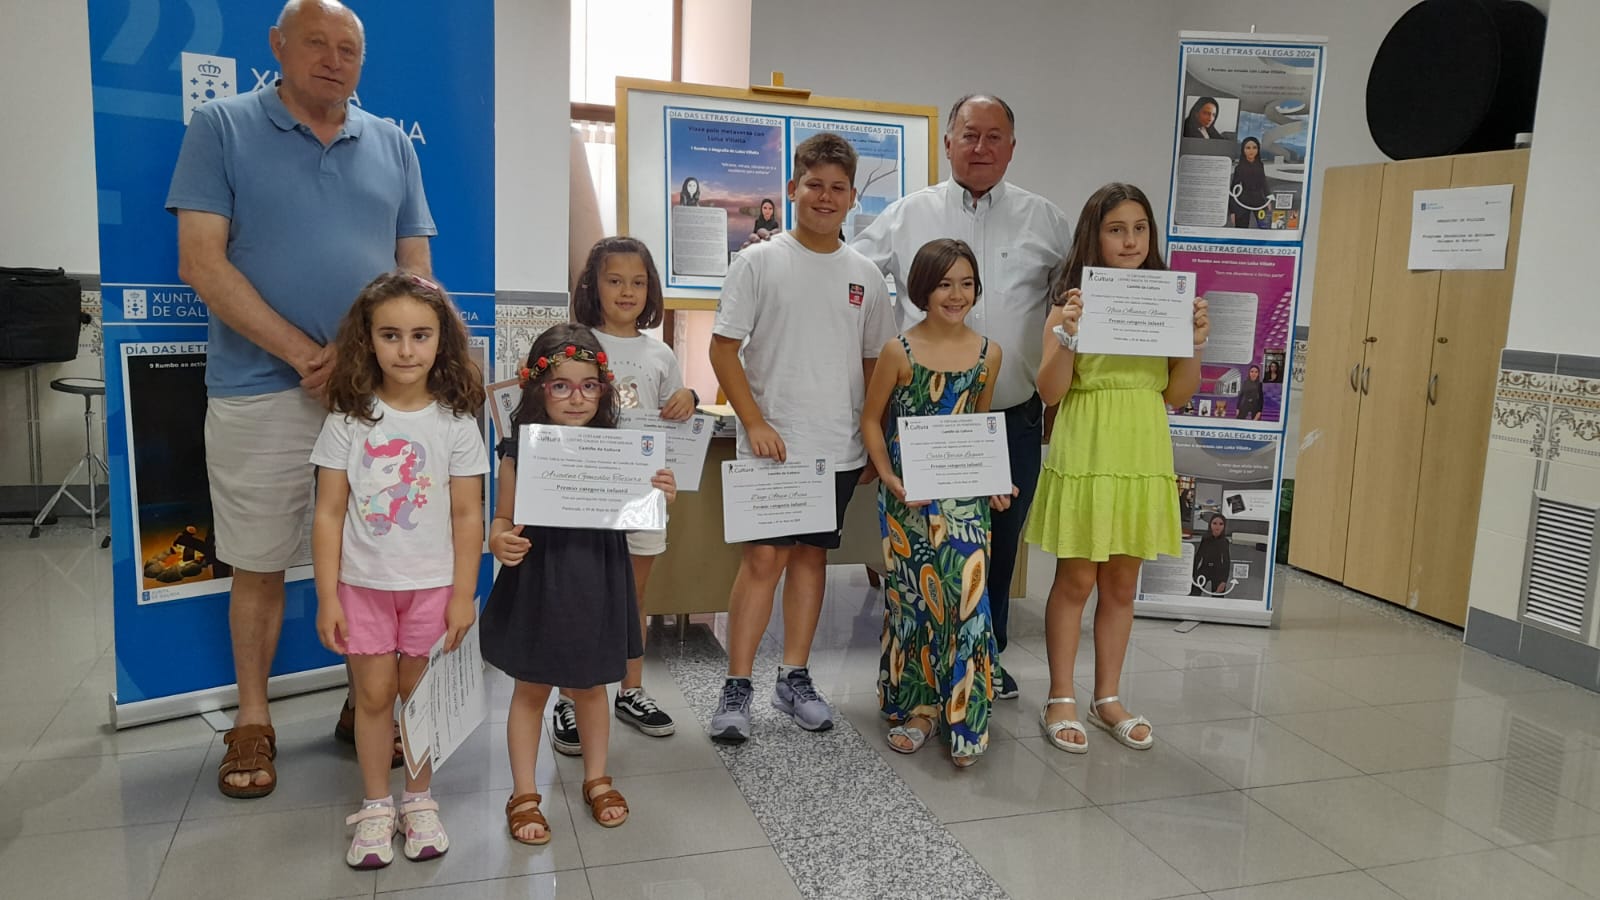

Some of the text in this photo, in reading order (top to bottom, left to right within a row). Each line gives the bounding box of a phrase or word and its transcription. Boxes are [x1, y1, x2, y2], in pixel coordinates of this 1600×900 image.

[1221, 48, 1253, 56] LETRAS
[1255, 49, 1294, 57] GALEGAS
[700, 113, 728, 122] LETRAS
[730, 116, 764, 124] GALEGAS
[823, 123, 849, 131] LETRAS
[850, 125, 882, 133] GALEGAS
[1204, 245, 1234, 253] LETRAS
[1236, 246, 1275, 254] GALEGAS
[152, 292, 203, 304] XUNTA
[152, 306, 172, 317] DE
[126, 343, 148, 355] DÍA
[151, 344, 176, 354] DAS
[1185, 430, 1217, 438] LETRAS
[1218, 431, 1257, 440] GALEGAS
[556, 484, 578, 492] Premio
